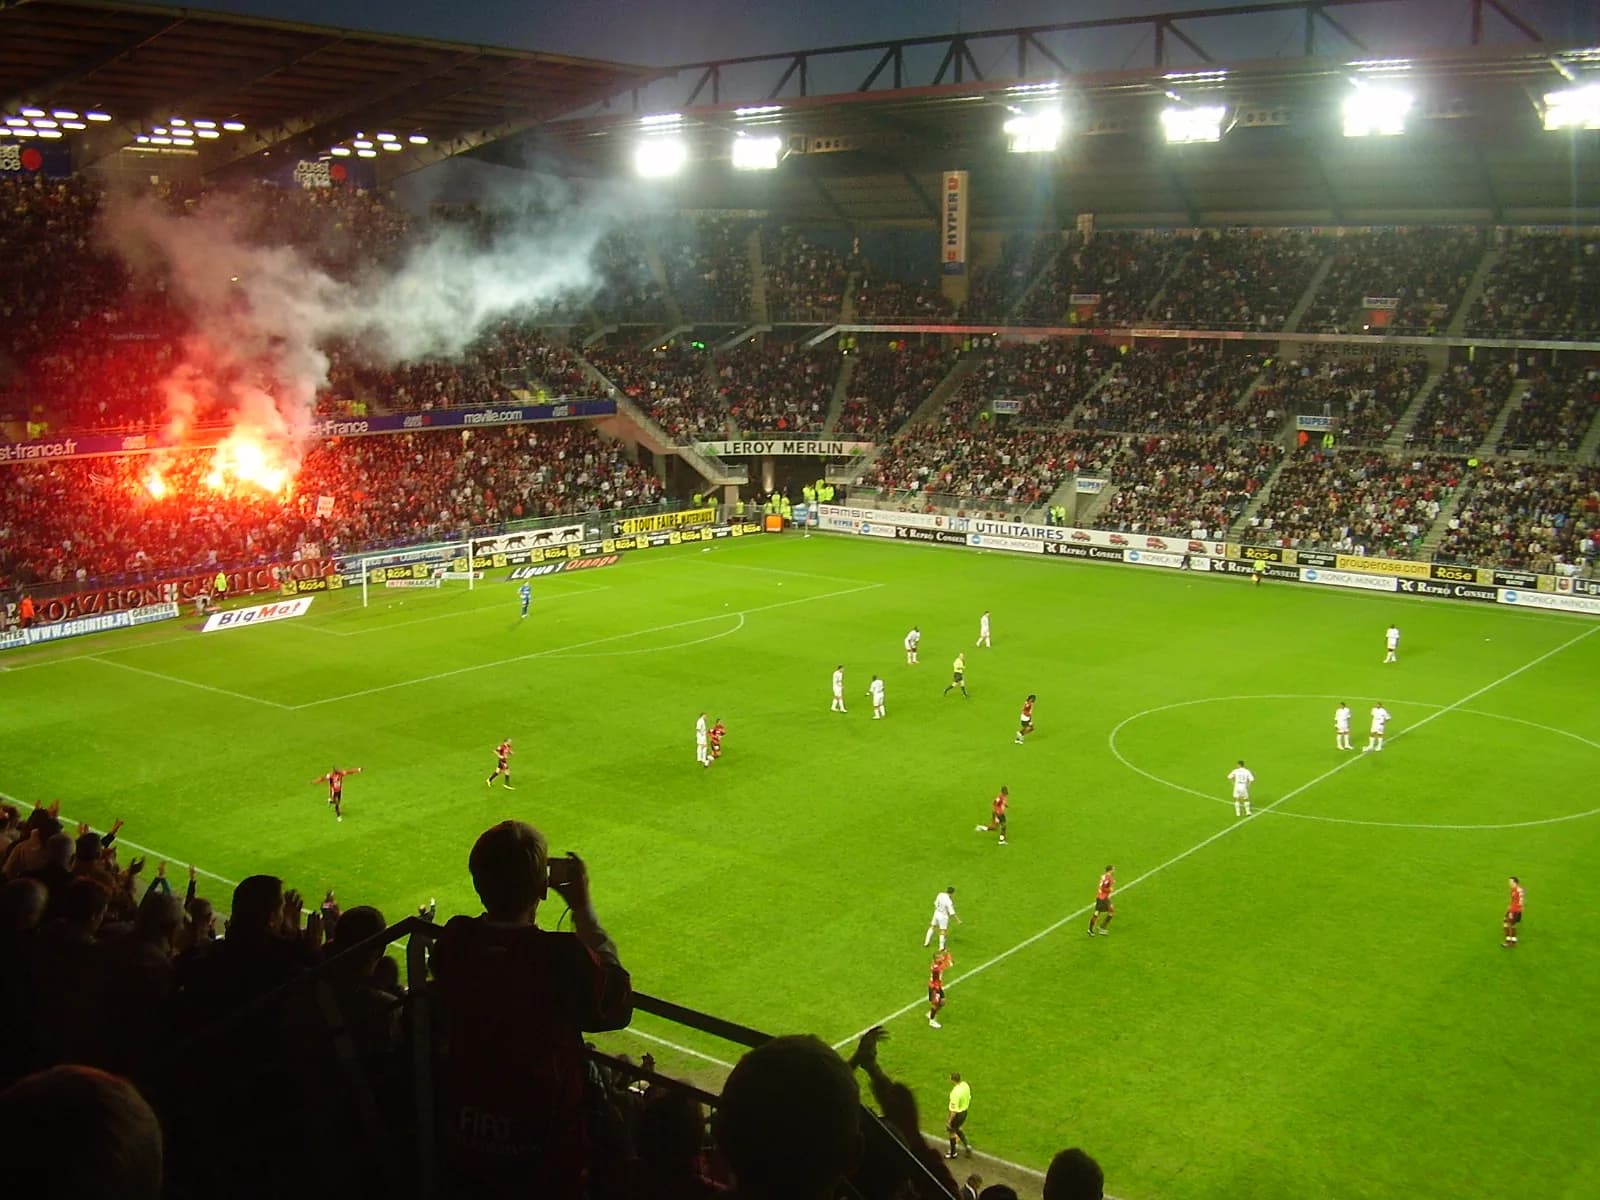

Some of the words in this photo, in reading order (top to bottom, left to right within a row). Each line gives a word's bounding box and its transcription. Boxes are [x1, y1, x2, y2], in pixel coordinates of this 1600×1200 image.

[723, 441, 775, 455] LEROY
[782, 441, 843, 455] MERLIN
[634, 517, 654, 531] TOUT
[656, 514, 679, 529] FAIRE
[976, 522, 1064, 540] UTILITAIRES
[1245, 547, 1278, 561] Rose
[511, 564, 554, 579] Ligue
[565, 555, 619, 570] Orange
[1339, 556, 1429, 575] grouperose.com
[1436, 566, 1473, 581] Rose
[131, 602, 175, 618] GERINTER
[218, 601, 301, 626] BigMat
